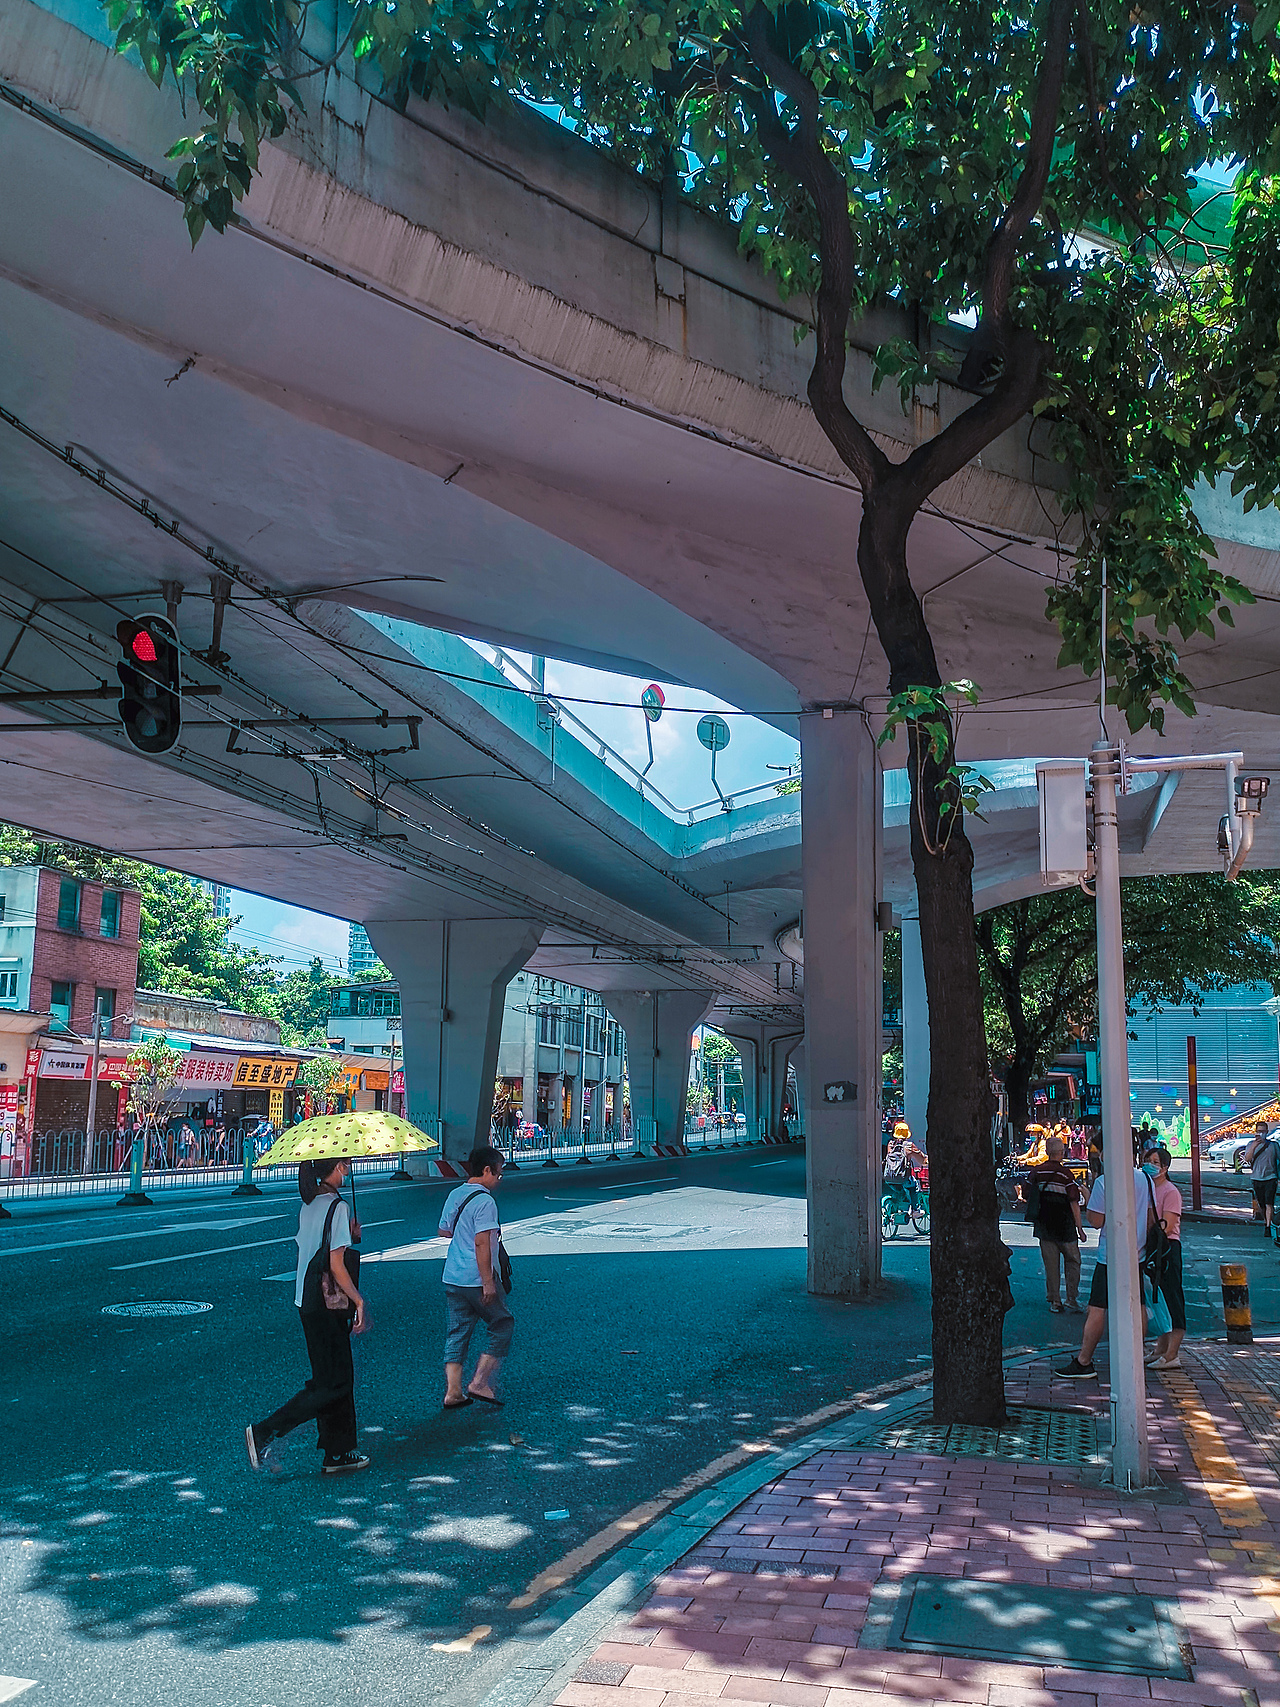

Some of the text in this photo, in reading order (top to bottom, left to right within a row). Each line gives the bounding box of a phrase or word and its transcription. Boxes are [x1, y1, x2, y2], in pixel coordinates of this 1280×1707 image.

[27, 1050, 39, 1075] 彩票
[236, 1061, 294, 1084] 信至盛地产
